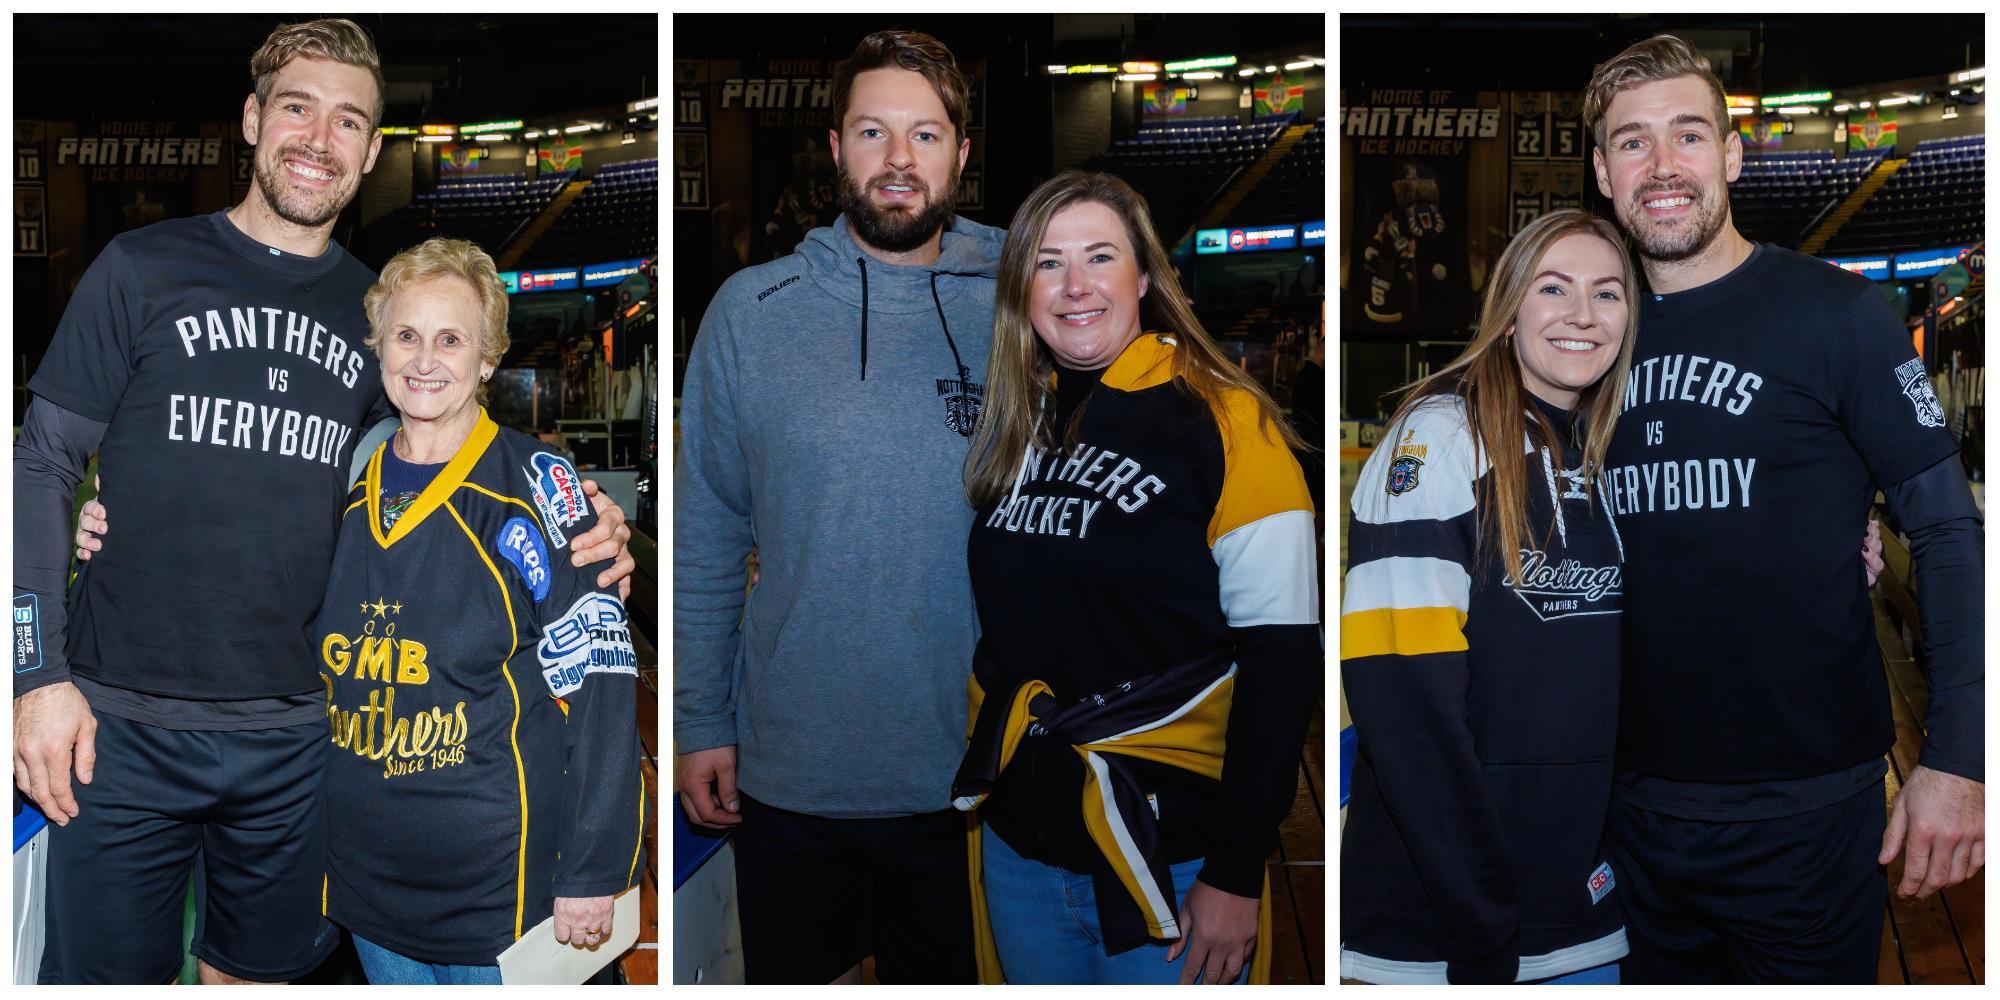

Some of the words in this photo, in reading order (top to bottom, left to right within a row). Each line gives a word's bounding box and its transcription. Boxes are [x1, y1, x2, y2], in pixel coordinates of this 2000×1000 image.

[721, 78, 833, 108] PANTH
[1371, 88, 1423, 104] HOME
[1429, 89, 1453, 105] OF
[679, 99, 701, 123] 10
[101, 120, 150, 135] HOME
[1517, 129, 1540, 154] 22
[1560, 129, 1573, 154] 5
[57, 136, 222, 166] PANTHERS
[1360, 138, 1390, 155] ICE
[1395, 139, 1464, 156] HOCKEY
[18, 156, 40, 179] 10
[757, 275, 801, 302] BAUER
[175, 307, 364, 389] PANTHERS
[268, 367, 289, 393] VS
[936, 378, 986, 397] NOTTINGHA
[1619, 354, 1763, 416] NTHERS
[168, 394, 352, 468] EVERYBODY
[1646, 421, 1664, 446] VS
[552, 465, 576, 519] CAPITAL
[1022, 443, 1167, 513] NTHERS
[1604, 458, 1756, 516] VERYBODY
[553, 499, 569, 518] FM
[986, 494, 1102, 539] HOCKEY
[16, 626, 27, 665] SPORTS
[24, 625, 34, 654] BLUE
[322, 632, 430, 685] GMB
[383, 754, 425, 779] Since
[431, 744, 466, 770] 1946
